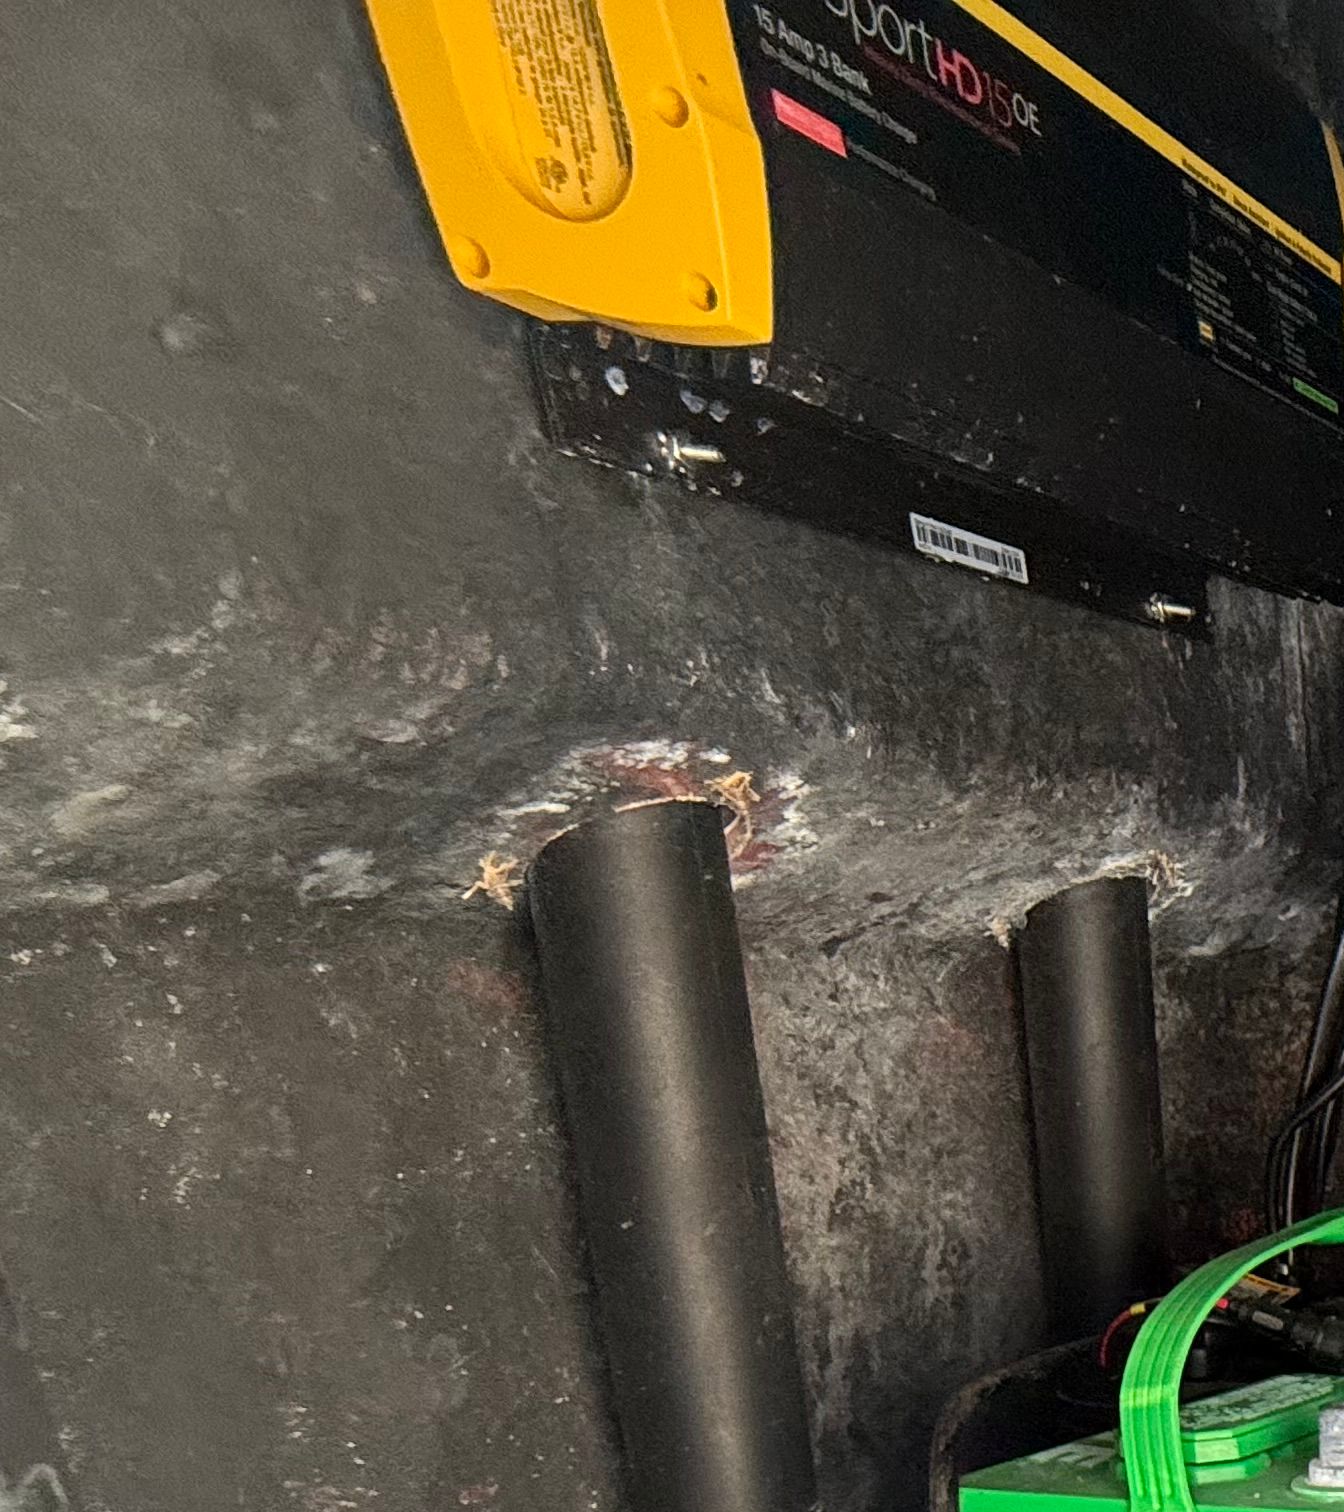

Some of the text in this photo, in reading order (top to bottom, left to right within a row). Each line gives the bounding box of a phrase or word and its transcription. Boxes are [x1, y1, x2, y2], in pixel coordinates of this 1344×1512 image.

[753, 4, 872, 96] 15 Amp 3 Bank
